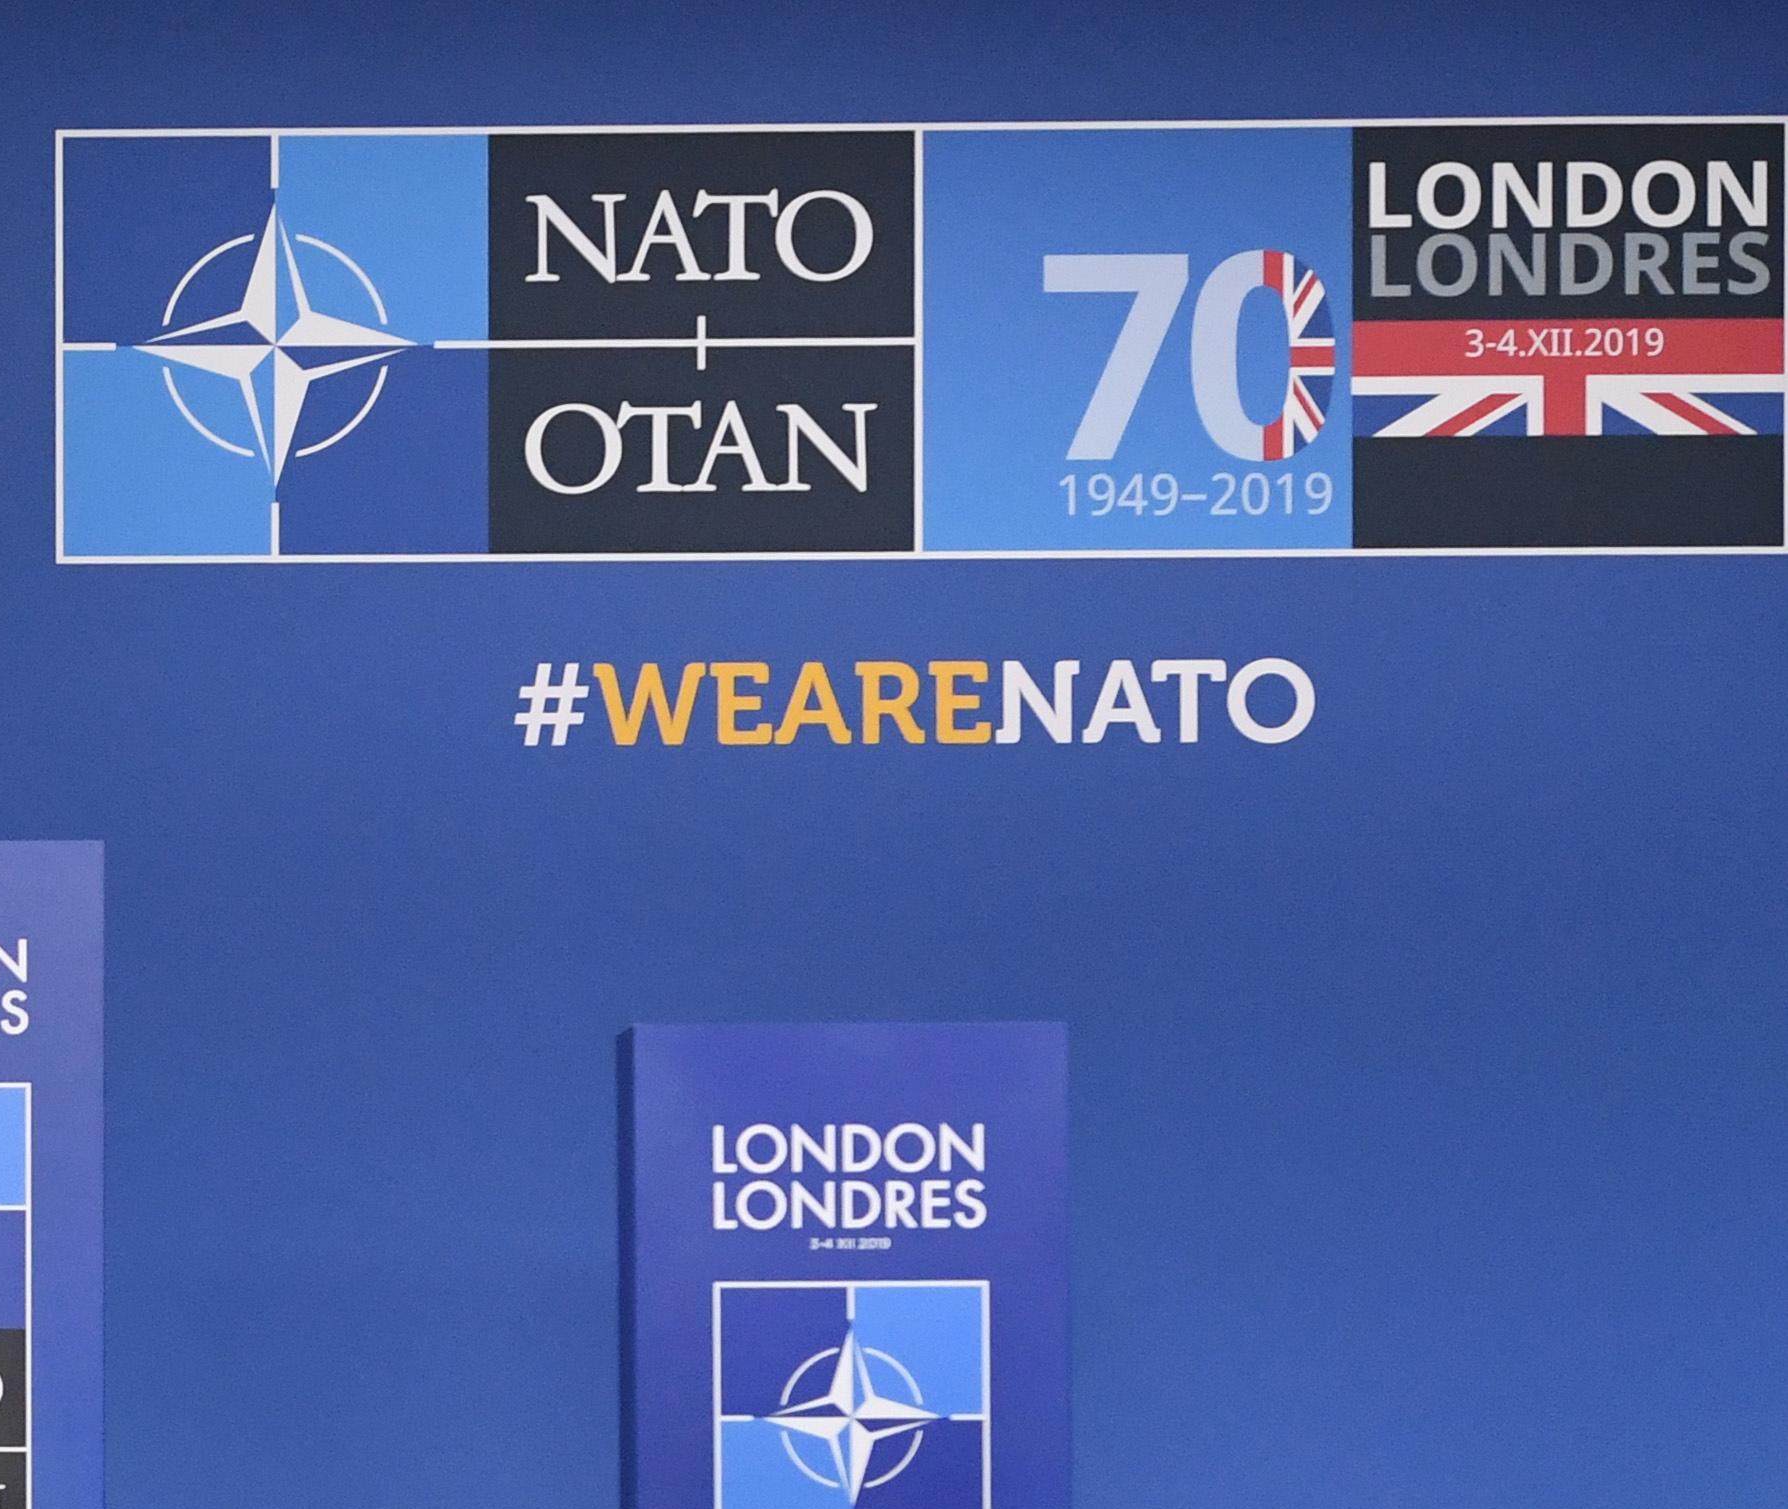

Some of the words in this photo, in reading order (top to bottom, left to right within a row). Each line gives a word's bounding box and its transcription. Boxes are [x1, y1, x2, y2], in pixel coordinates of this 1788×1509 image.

[1370, 161, 1767, 229] LONDON
[525, 189, 873, 283] NATO
[1371, 233, 1769, 297] LONDRES
[1044, 250, 1336, 461] 70
[1464, 326, 1665, 359] 3-4.XII.2019
[525, 401, 877, 494] OTAN
[515, 658, 1315, 746] #WEARENATO
[713, 1123, 984, 1173] LONDON
[713, 1179, 986, 1229] LONDRES
